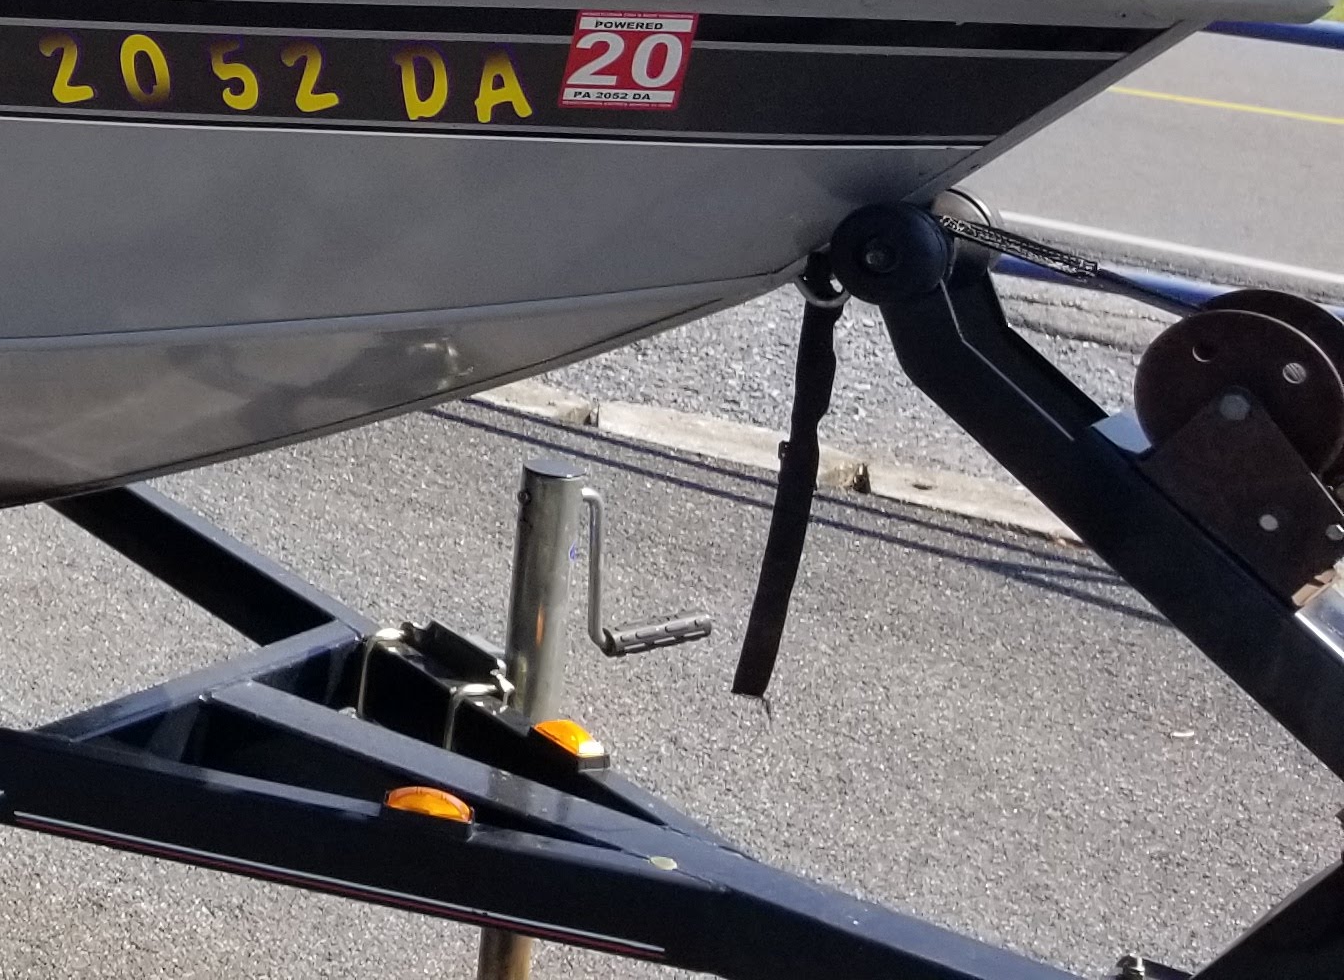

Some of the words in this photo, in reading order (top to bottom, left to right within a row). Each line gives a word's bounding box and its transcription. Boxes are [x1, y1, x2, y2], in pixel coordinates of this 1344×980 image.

[594, 19, 664, 30] POWERED
[565, 31, 683, 88] 20
[394, 43, 533, 124] DA
[573, 91, 591, 99] PA
[632, 92, 651, 101] DA
